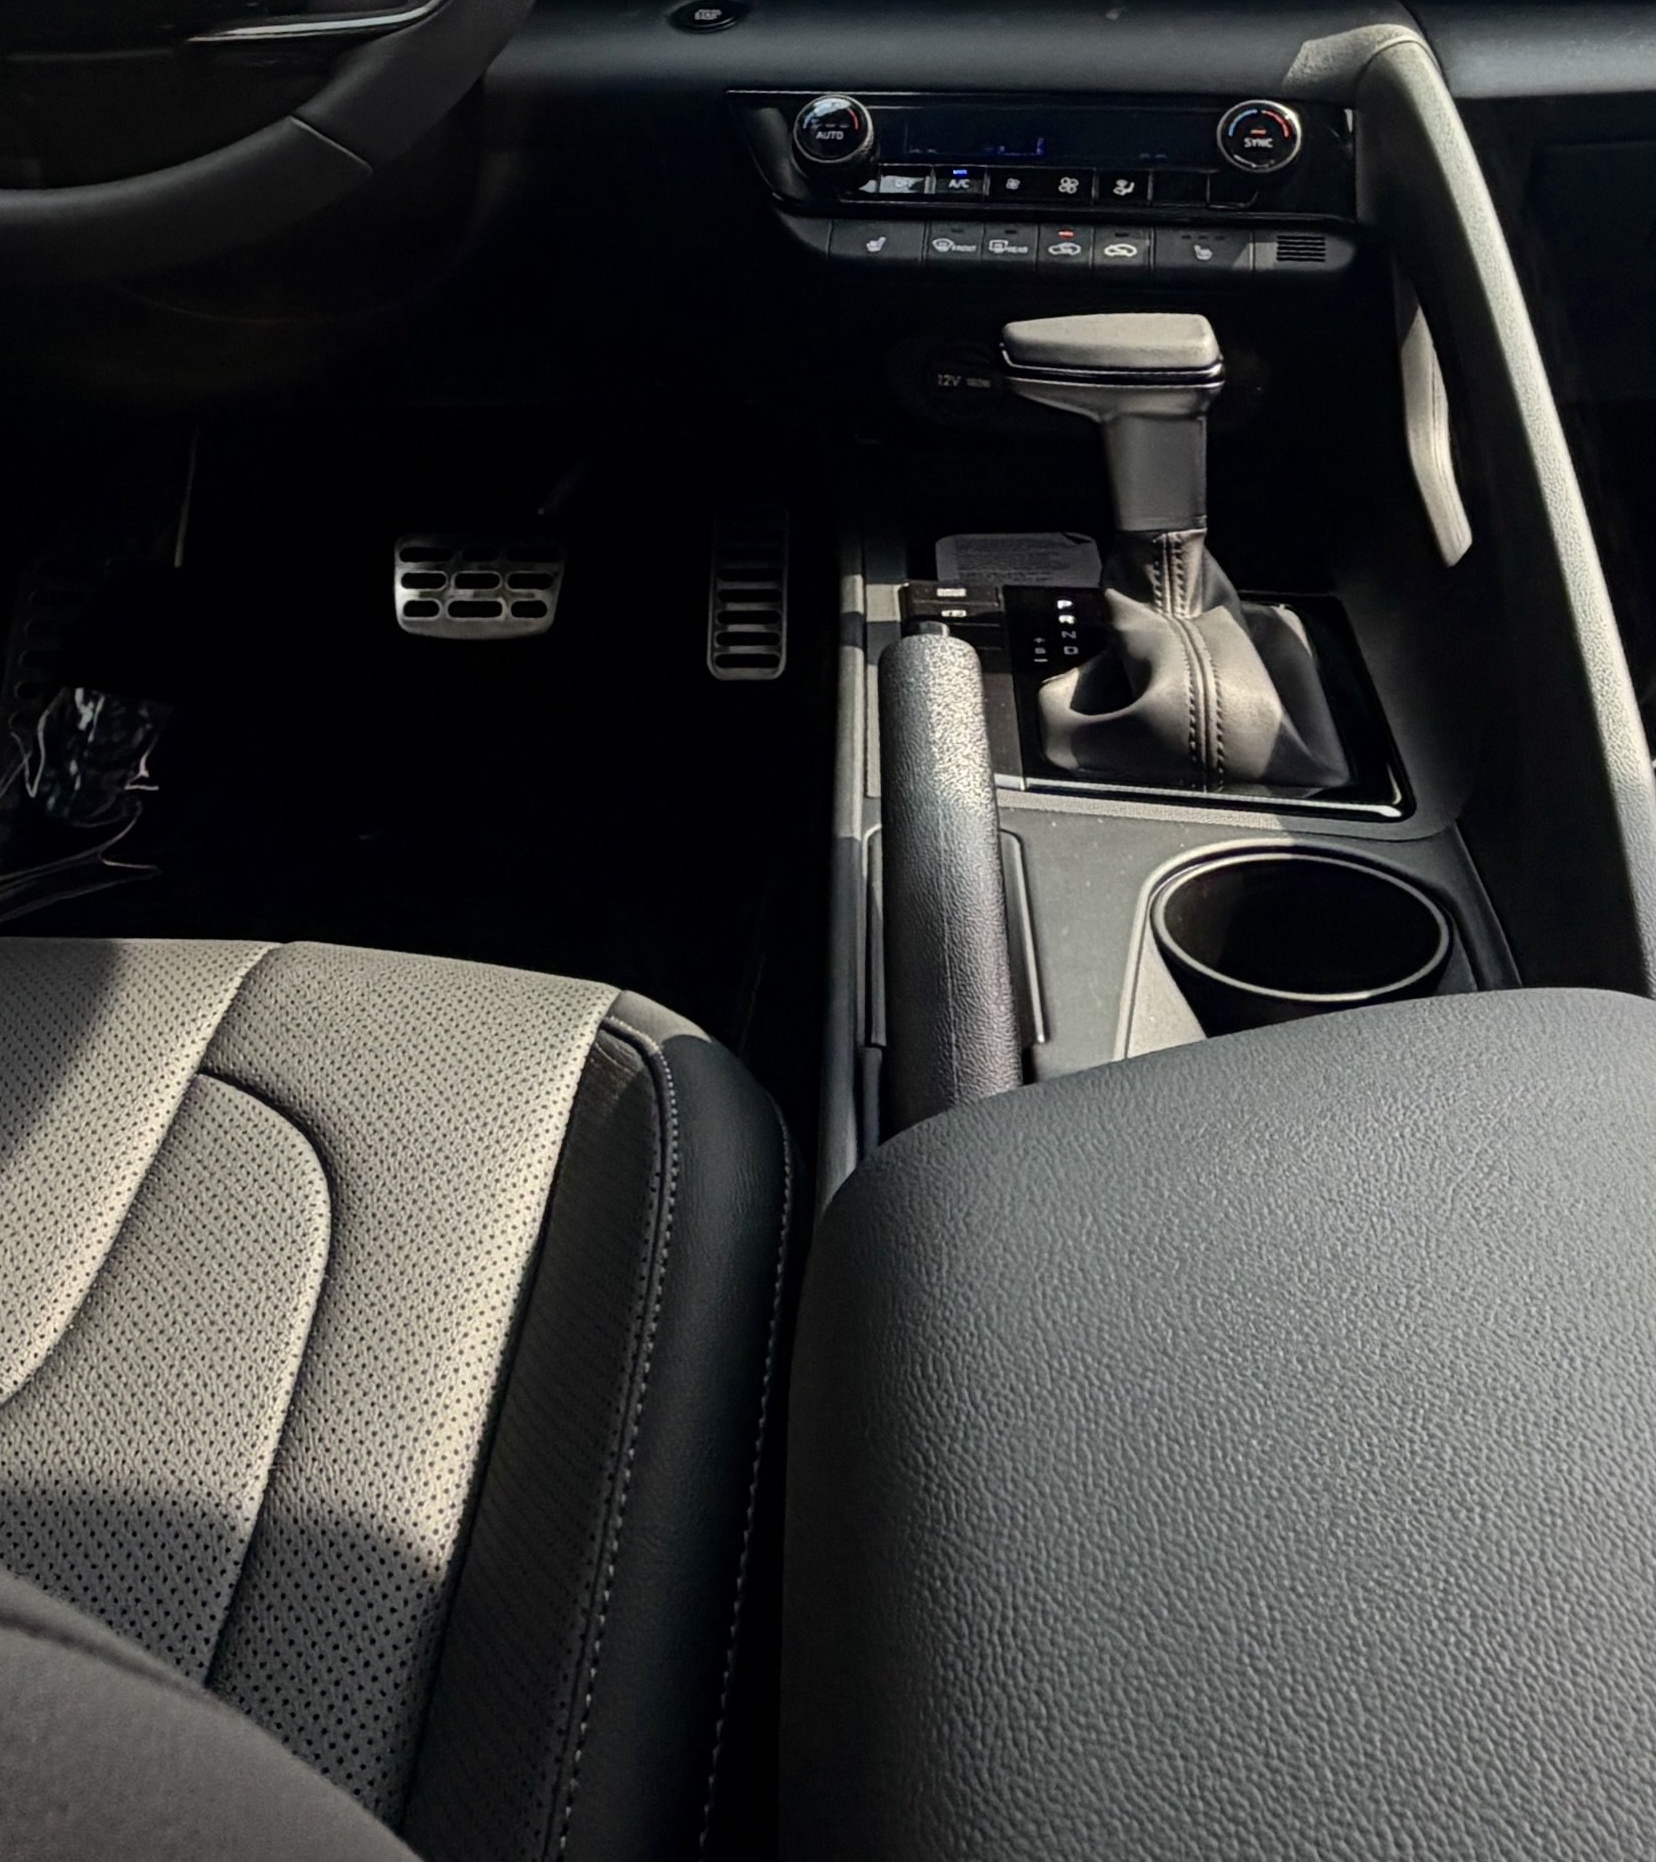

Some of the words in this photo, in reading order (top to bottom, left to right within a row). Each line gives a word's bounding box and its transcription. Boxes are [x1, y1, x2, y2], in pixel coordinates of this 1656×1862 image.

[815, 130, 844, 141] AUTO
[1243, 138, 1273, 148] SYNC
[948, 178, 970, 189] A/C
[937, 373, 962, 387] 12V
